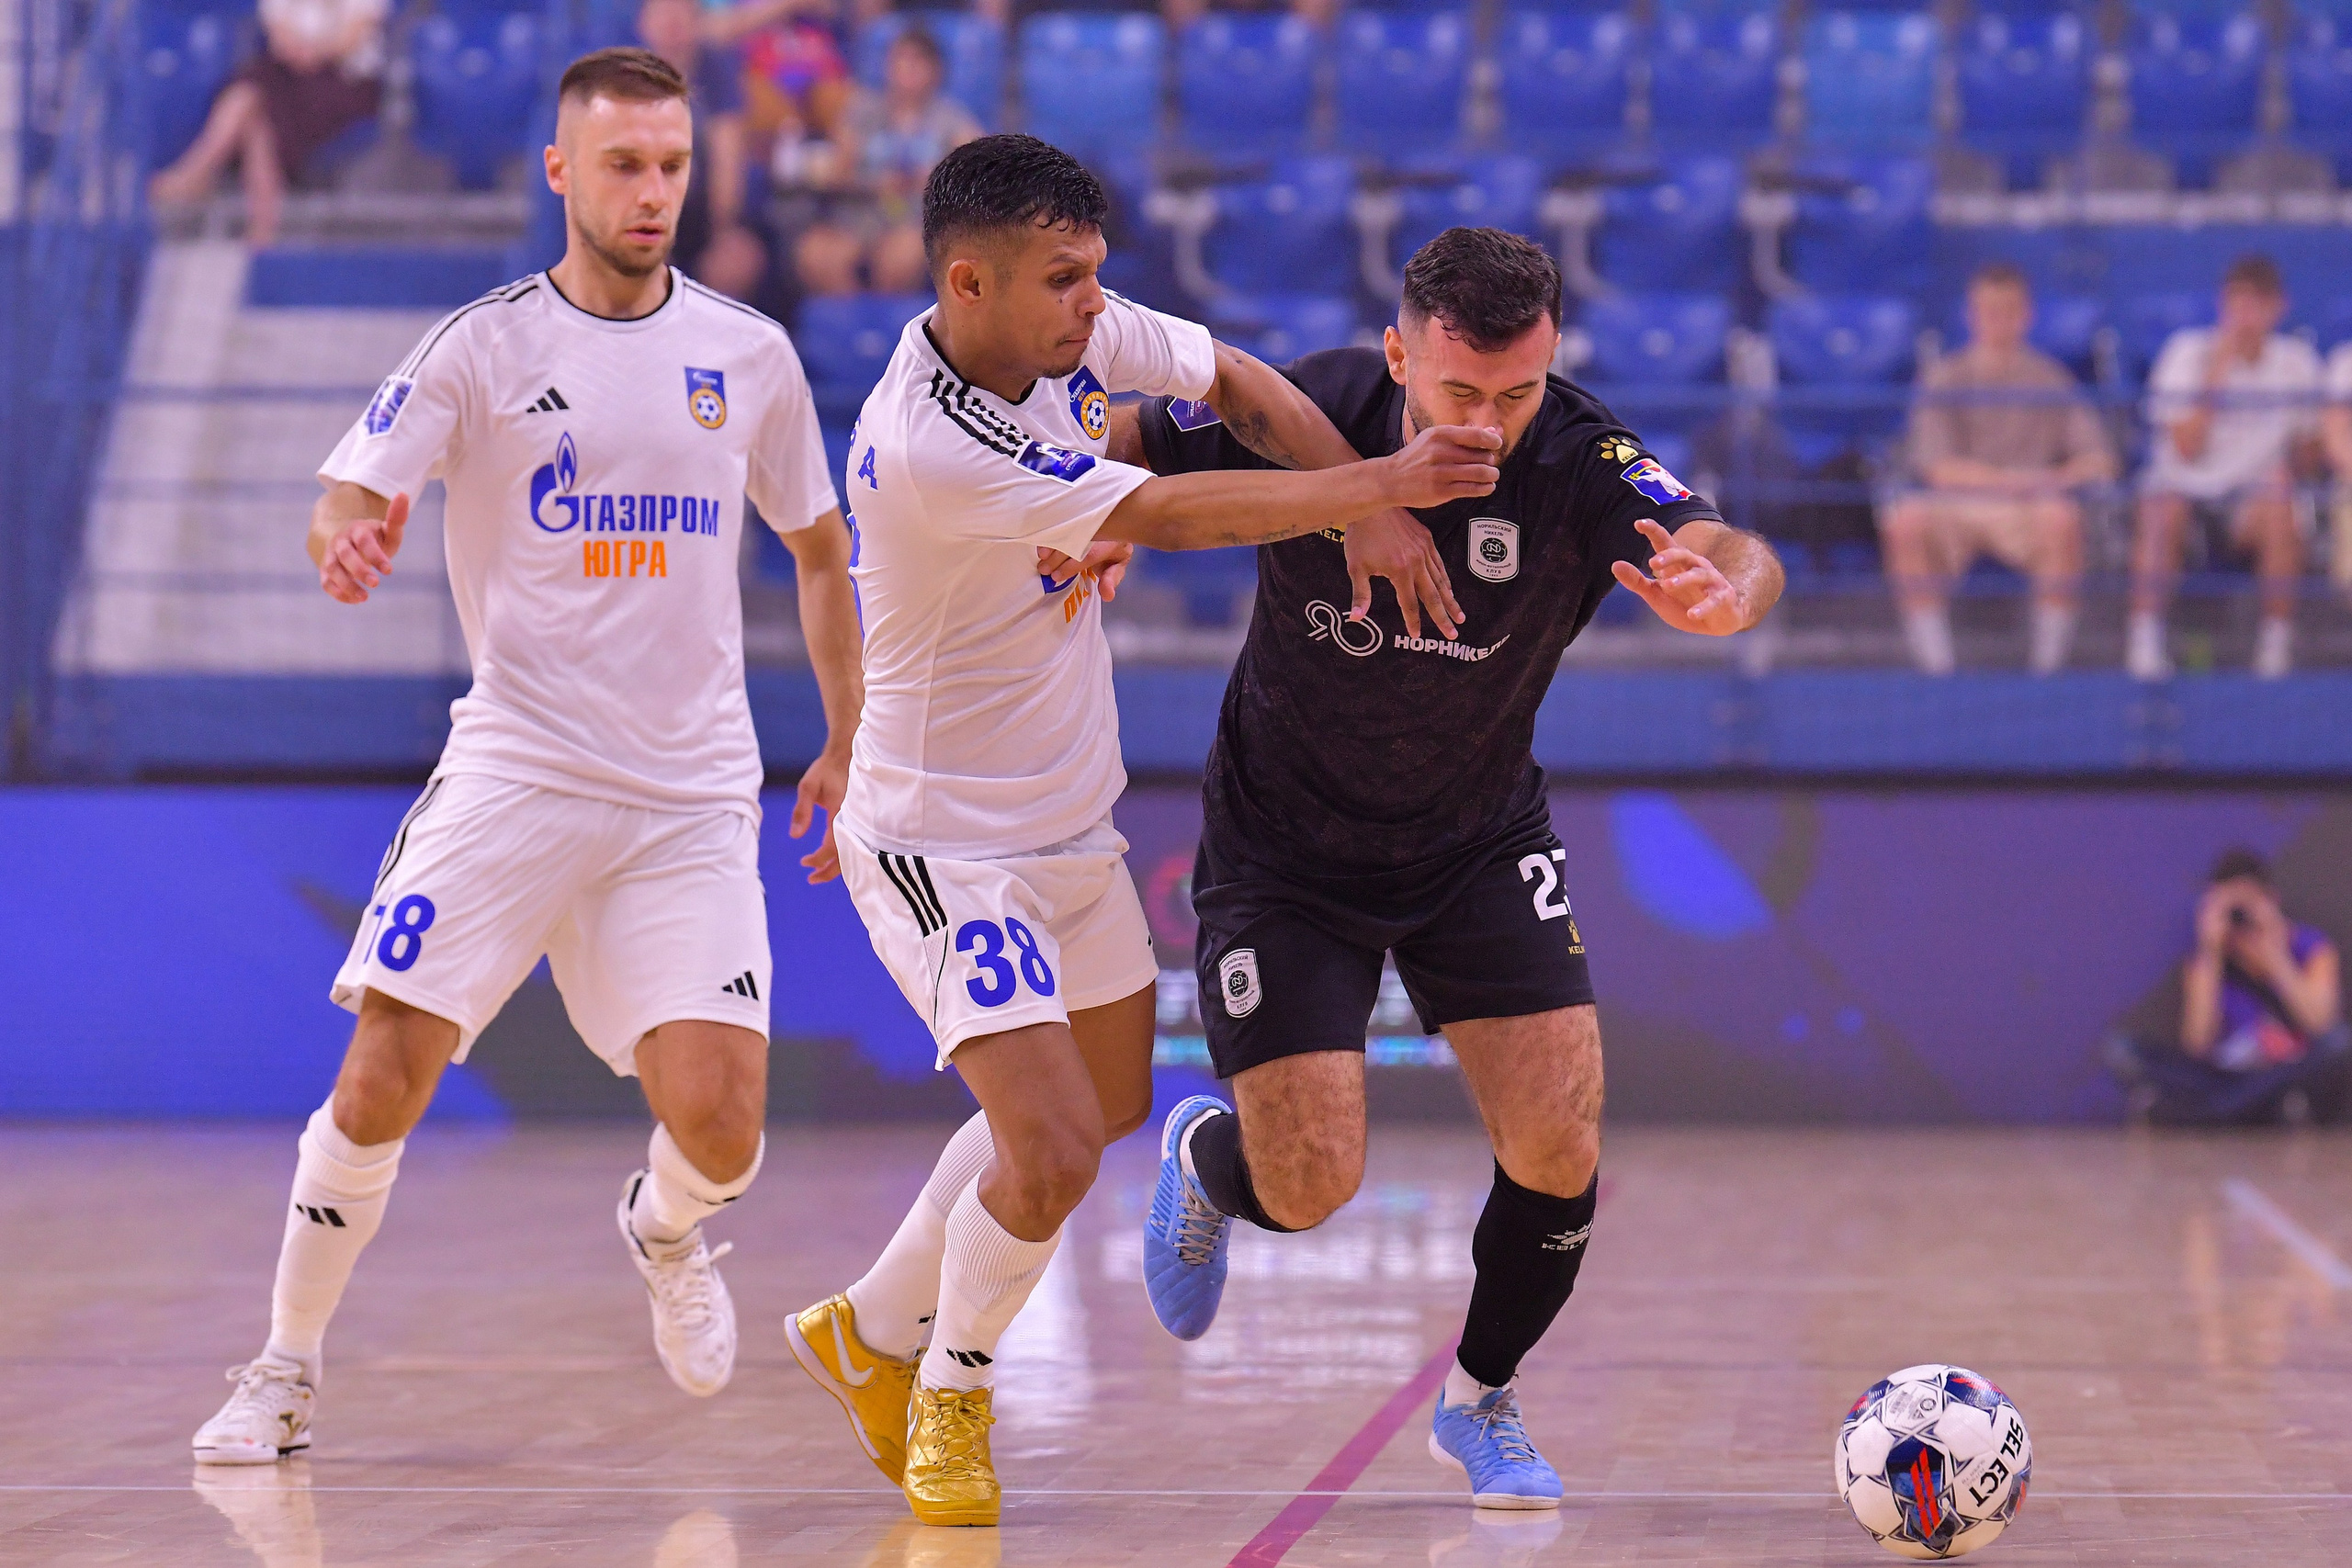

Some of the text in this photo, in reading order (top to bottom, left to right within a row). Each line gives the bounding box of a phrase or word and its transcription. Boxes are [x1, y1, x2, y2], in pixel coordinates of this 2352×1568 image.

[583, 494, 719, 536] ГАЗПРОМ
[1476, 524, 1512, 533] НОРИЛЬСКИЙ
[583, 540, 668, 578] ЮГРА
[956, 917, 1056, 1008] 38
[1968, 1416, 2024, 1507] SELECT
